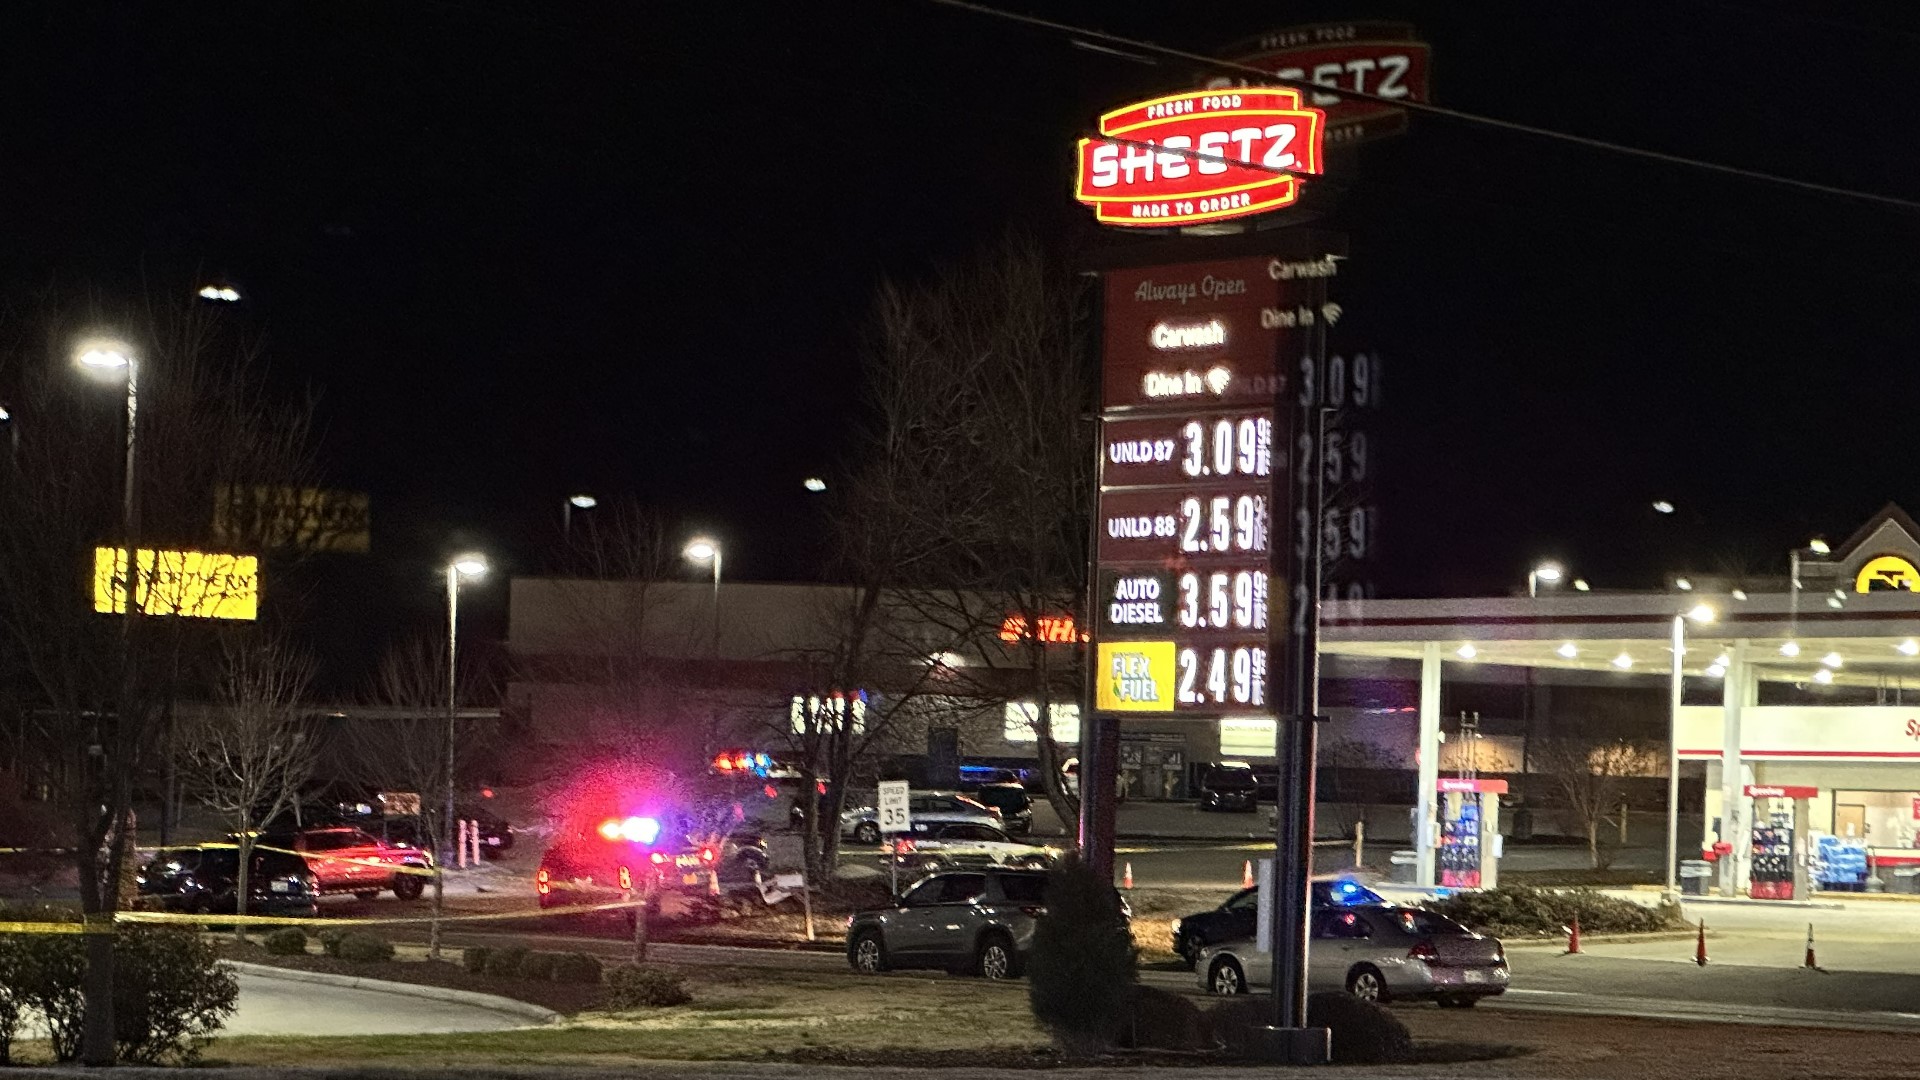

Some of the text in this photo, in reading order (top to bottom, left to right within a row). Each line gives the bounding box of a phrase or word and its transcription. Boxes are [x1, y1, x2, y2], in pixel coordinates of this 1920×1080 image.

[1147, 95, 1241, 119] FRESH FOOD
[1092, 124, 1297, 188] SHEETZ
[1132, 194, 1250, 218] MADE TO ORDER
[1135, 275, 1247, 304] Always Open
[1154, 321, 1225, 349] Carwash
[1144, 371, 1203, 398] Dine In
[1110, 441, 1151, 463] UNLD
[1154, 440, 1175, 461] 87
[1108, 518, 1151, 538] UNLD
[1154, 516, 1176, 536] 88
[1115, 578, 1160, 600] AUTO
[1111, 603, 1163, 624] DIESEL
[1112, 653, 1151, 679] FLEX
[1119, 679, 1160, 702] FUEL
[885, 807, 905, 826] 35
